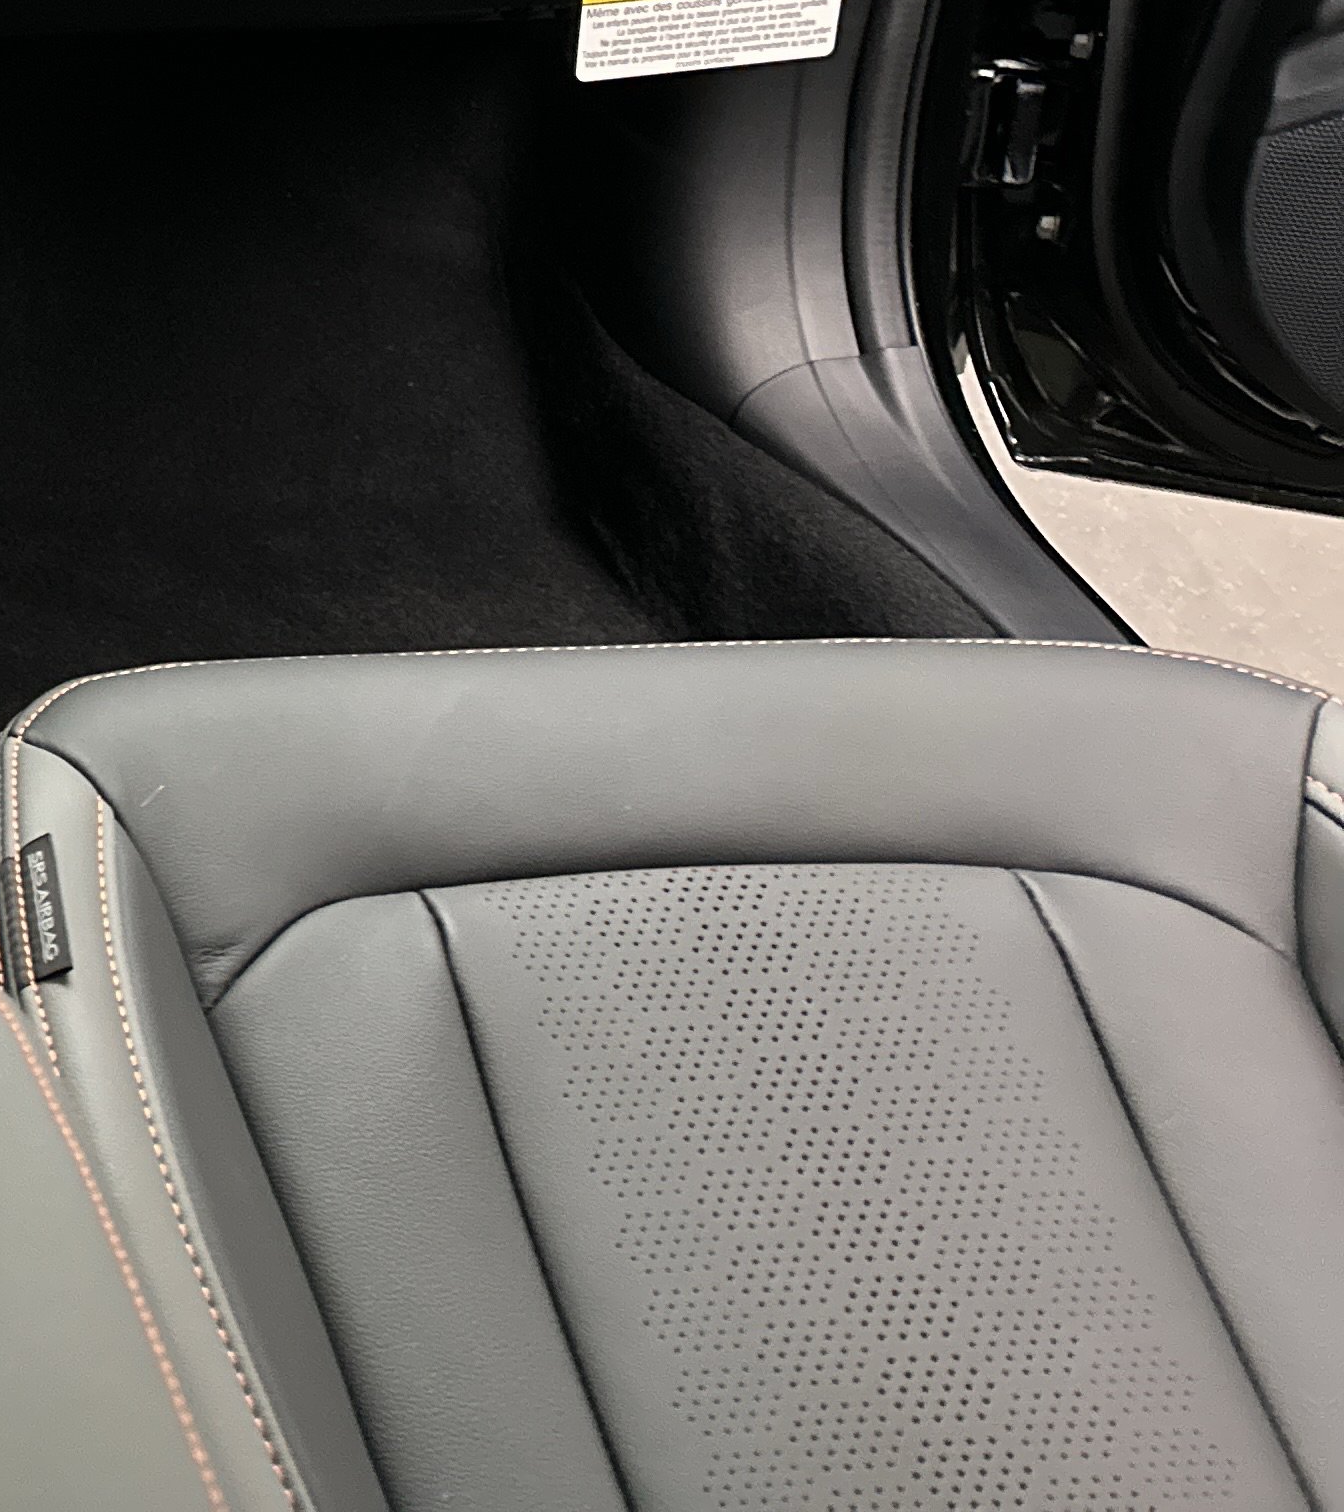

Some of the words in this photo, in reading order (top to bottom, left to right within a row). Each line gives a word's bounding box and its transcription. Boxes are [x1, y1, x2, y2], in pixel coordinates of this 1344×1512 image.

[623, 4, 649, 15] avec
[652, 2, 673, 12] des
[35, 890, 60, 962] AIRBAG
